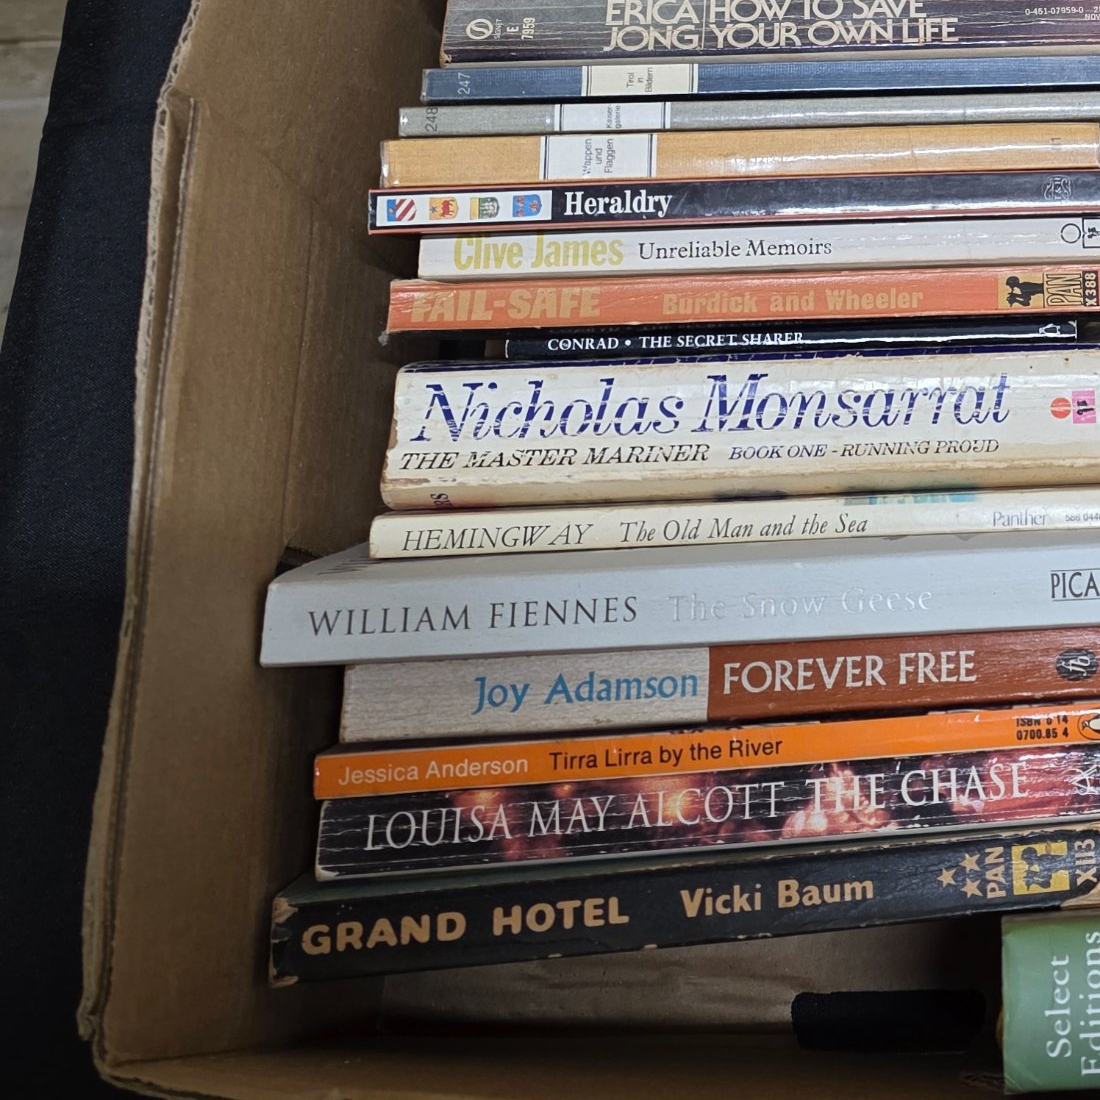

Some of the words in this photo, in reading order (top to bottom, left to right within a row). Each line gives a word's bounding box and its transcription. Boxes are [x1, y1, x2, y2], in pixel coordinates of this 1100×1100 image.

[564, 190, 673, 218] Heraldry
[1085, 272, 1097, 307] X388
[547, 338, 619, 351] CONRAD
[639, 336, 672, 349] THE
[676, 334, 736, 348] SECRET
[739, 332, 803, 346] SHARER
[410, 379, 684, 442] Nicholas
[691, 372, 1010, 433] Monsarrat
[472, 676, 530, 715] Joy
[543, 671, 699, 704] Adamson
[723, 660, 886, 694] FOREVER
[899, 650, 977, 684] FREE
[338, 764, 419, 787] Jessica
[425, 756, 529, 780] Anderson
[549, 750, 598, 771] Tirra
[605, 747, 653, 768] Lirra
[659, 746, 683, 767] by
[695, 741, 722, 760] the
[729, 737, 783, 758] River
[301, 911, 466, 956] GRAND
[493, 896, 630, 937] HOTEL
[681, 884, 762, 919] Vicki
[777, 877, 875, 910] Baum
